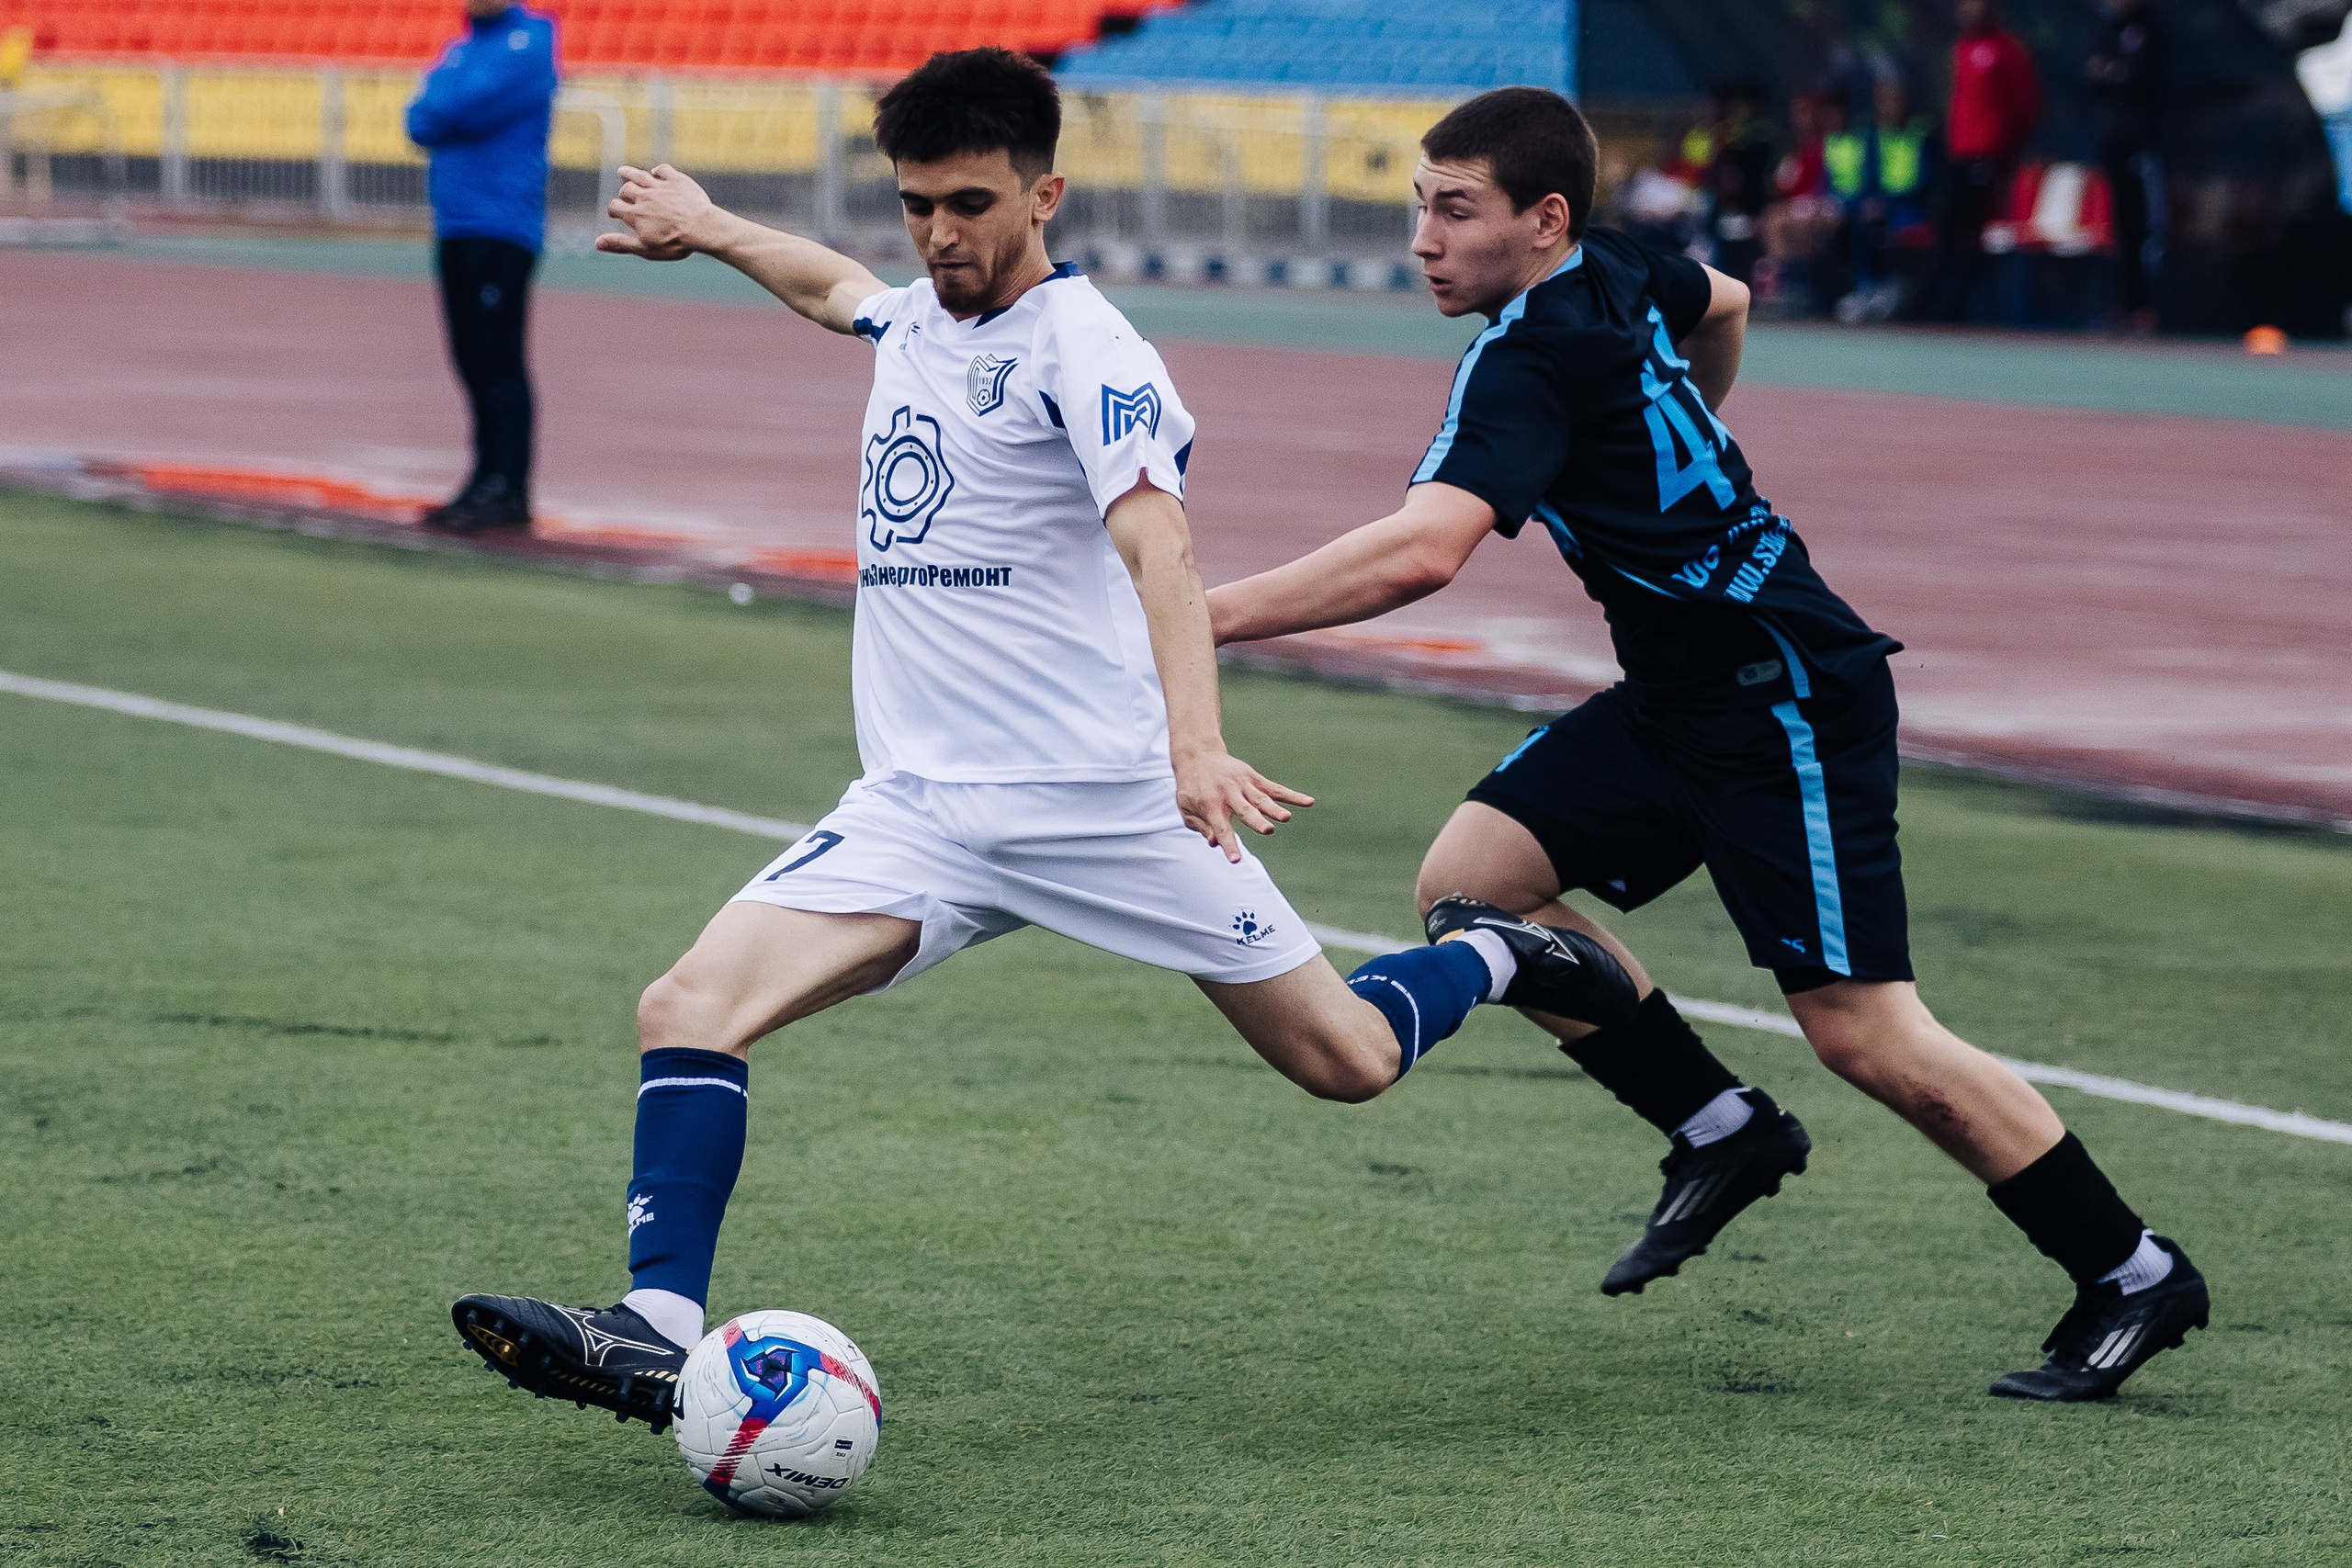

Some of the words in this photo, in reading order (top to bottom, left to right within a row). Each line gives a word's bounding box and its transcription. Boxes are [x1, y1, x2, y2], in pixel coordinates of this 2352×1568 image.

[859, 564, 1012, 588] нЭнергоРемонт
[763, 830, 845, 882] 7
[1236, 924, 1276, 945] KELME
[763, 1463, 850, 1489] DEMIX
